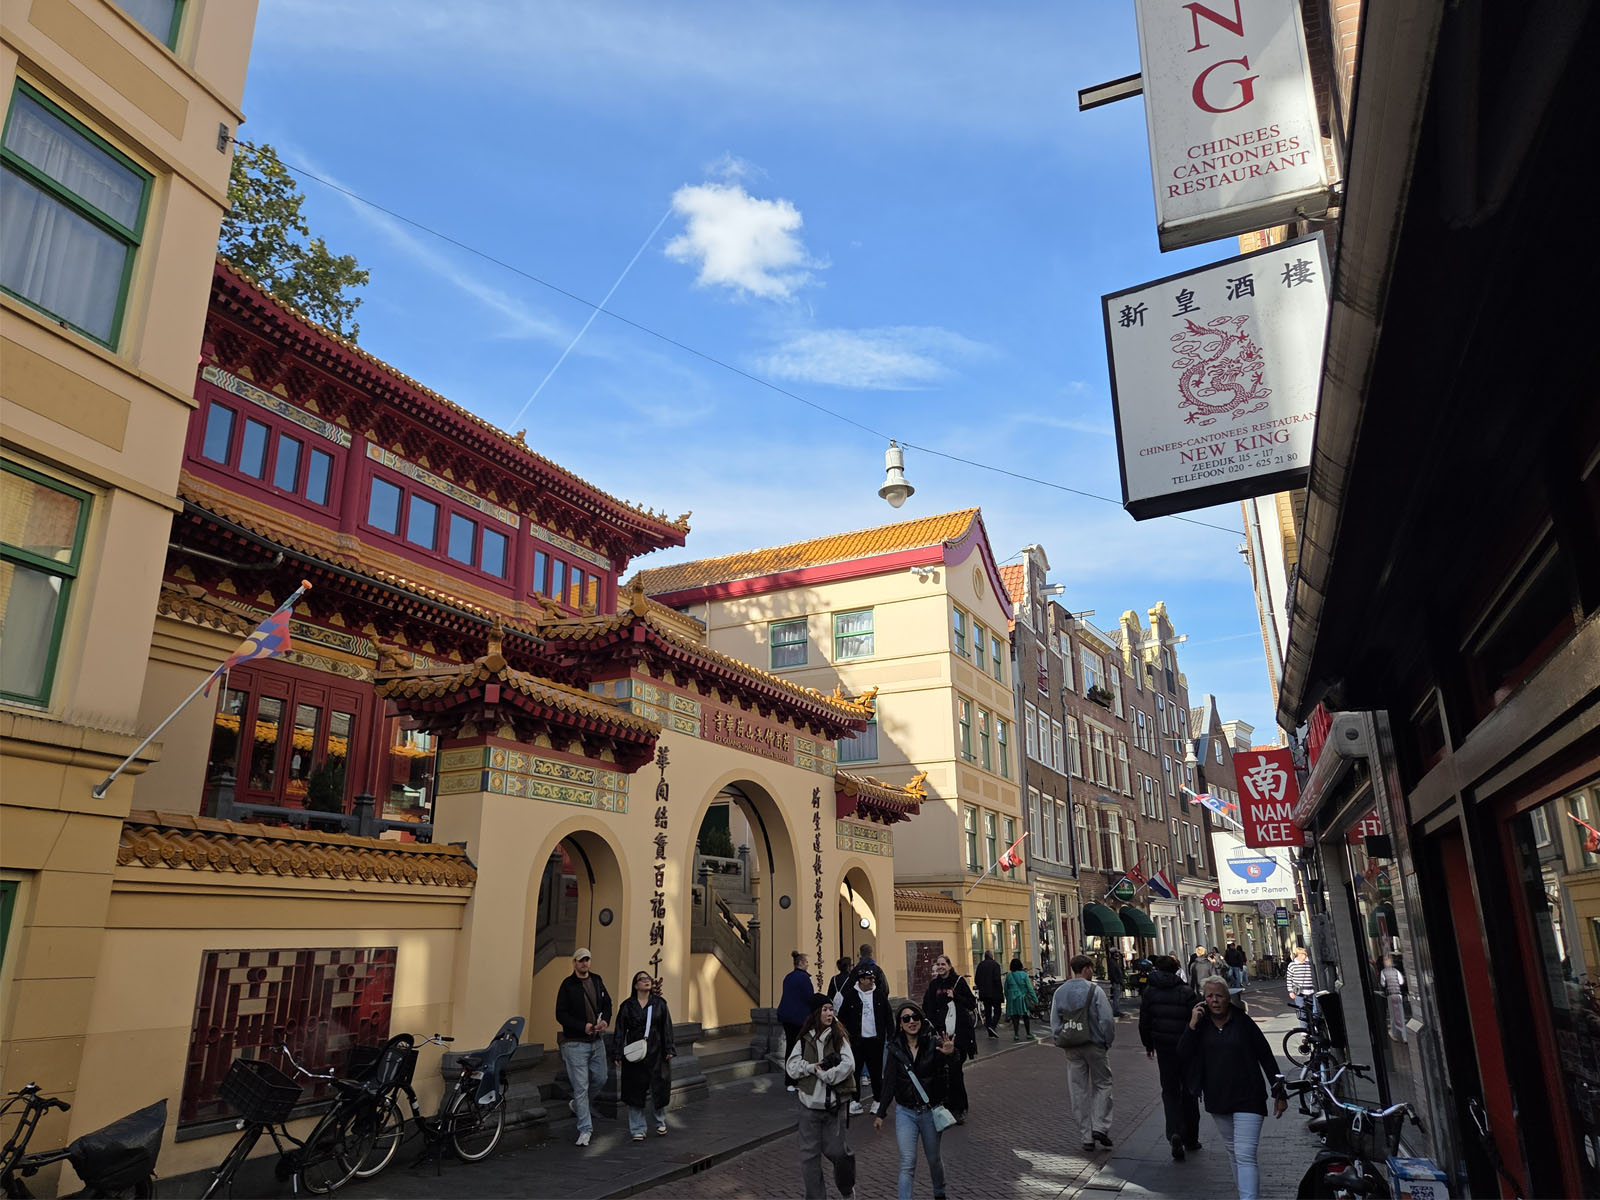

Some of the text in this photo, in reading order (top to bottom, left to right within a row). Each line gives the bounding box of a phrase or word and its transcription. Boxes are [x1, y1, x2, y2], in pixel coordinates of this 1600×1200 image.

[1173, 136, 1300, 180] CANTONEES
[1187, 124, 1281, 160] CHINEES
[1167, 150, 1310, 199] RESTAURANT
[1118, 258, 1316, 328] 新皇酒樓
[1139, 426, 1248, 457] CHINEES-CANTONEES
[1179, 428, 1290, 465] NEW KING
[1171, 467, 1225, 485] TELEFOON
[1228, 463, 1245, 473] 020
[1256, 457, 1272, 468] 625
[1275, 455, 1284, 465] 21
[1287, 452, 1298, 462] 80
[1192, 456, 1236, 472] ZEEDIJK
[1238, 453, 1251, 463] 115
[1262, 448, 1273, 458] 117
[1242, 755, 1288, 800] 南
[1251, 802, 1293, 822] NAM
[1256, 823, 1293, 842] KEE
[1206, 896, 1220, 907] YO!
[1227, 886, 1289, 895] Taste of Ramen
